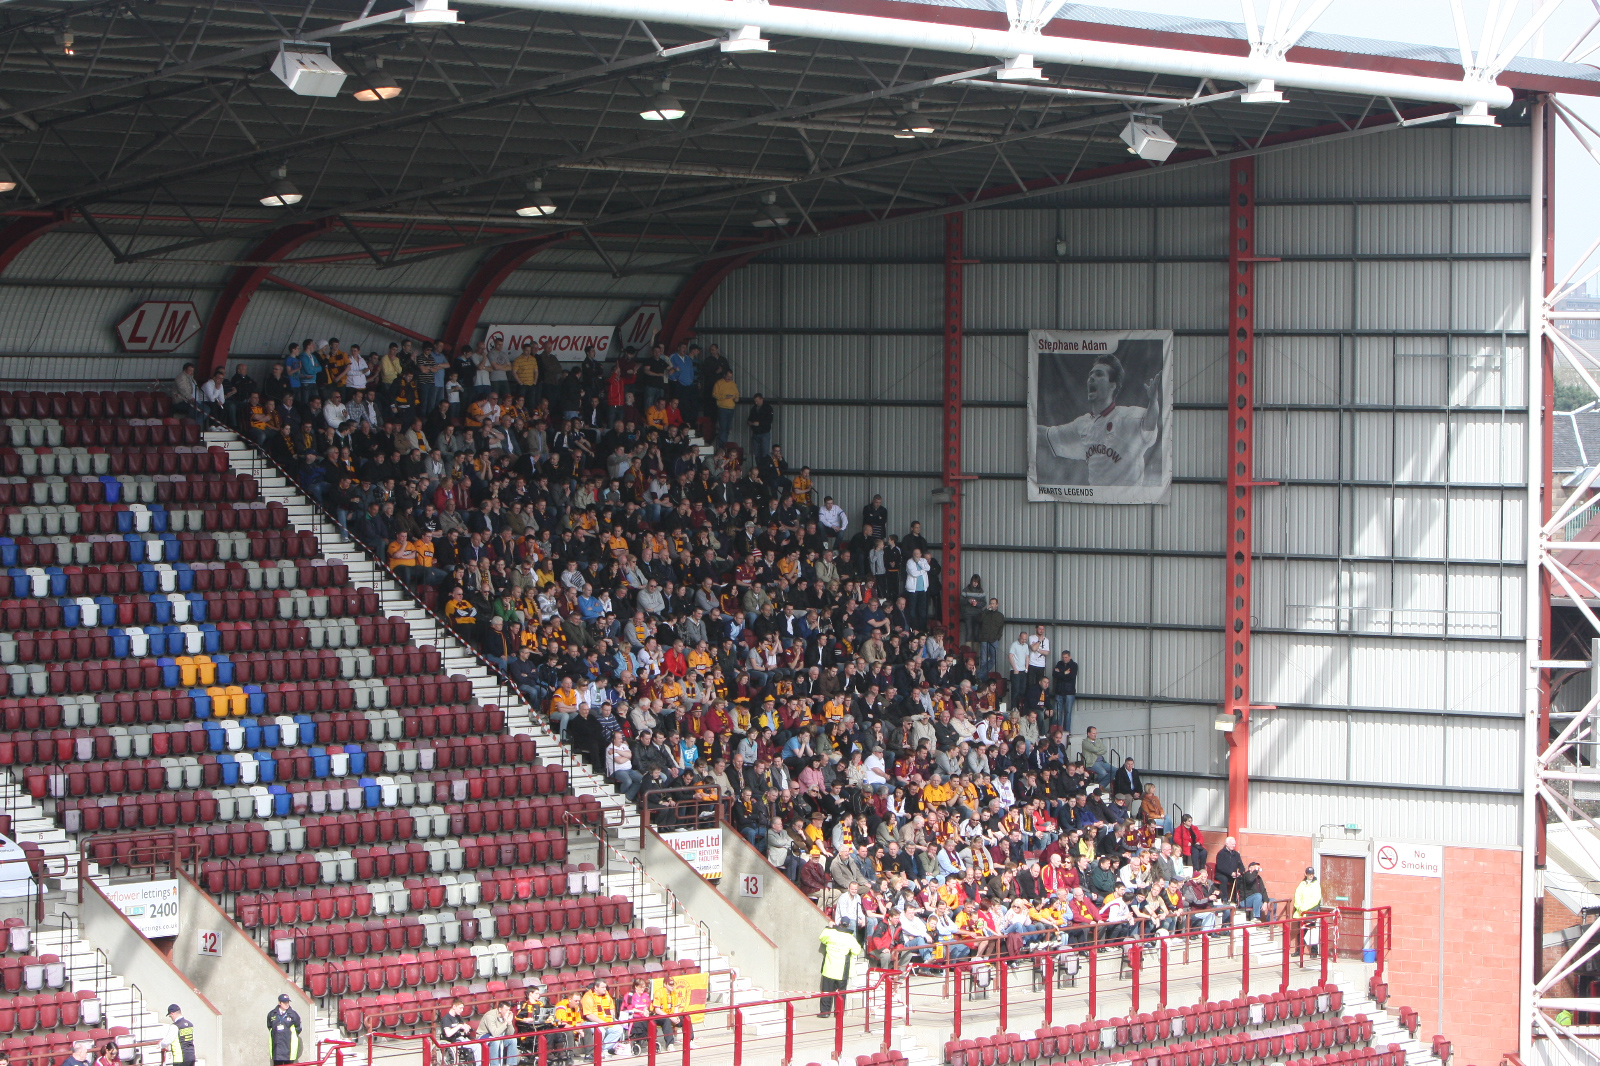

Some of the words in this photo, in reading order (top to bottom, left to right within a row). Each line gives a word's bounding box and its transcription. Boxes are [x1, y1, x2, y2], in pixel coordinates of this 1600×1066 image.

[1038, 339, 1079, 352] Stephane
[1082, 340, 1108, 351] Adam
[1038, 486, 1063, 496] HEARTS
[1064, 487, 1094, 497] LEGENDS
[674, 837, 705, 851] Kennie
[706, 834, 720, 848] Ltd
[1414, 850, 1426, 859] No
[1401, 860, 1438, 873] Smoking
[743, 876, 759, 895] 13
[142, 887, 171, 901] lettings
[149, 901, 178, 919] 2400
[202, 932, 218, 953] 12
